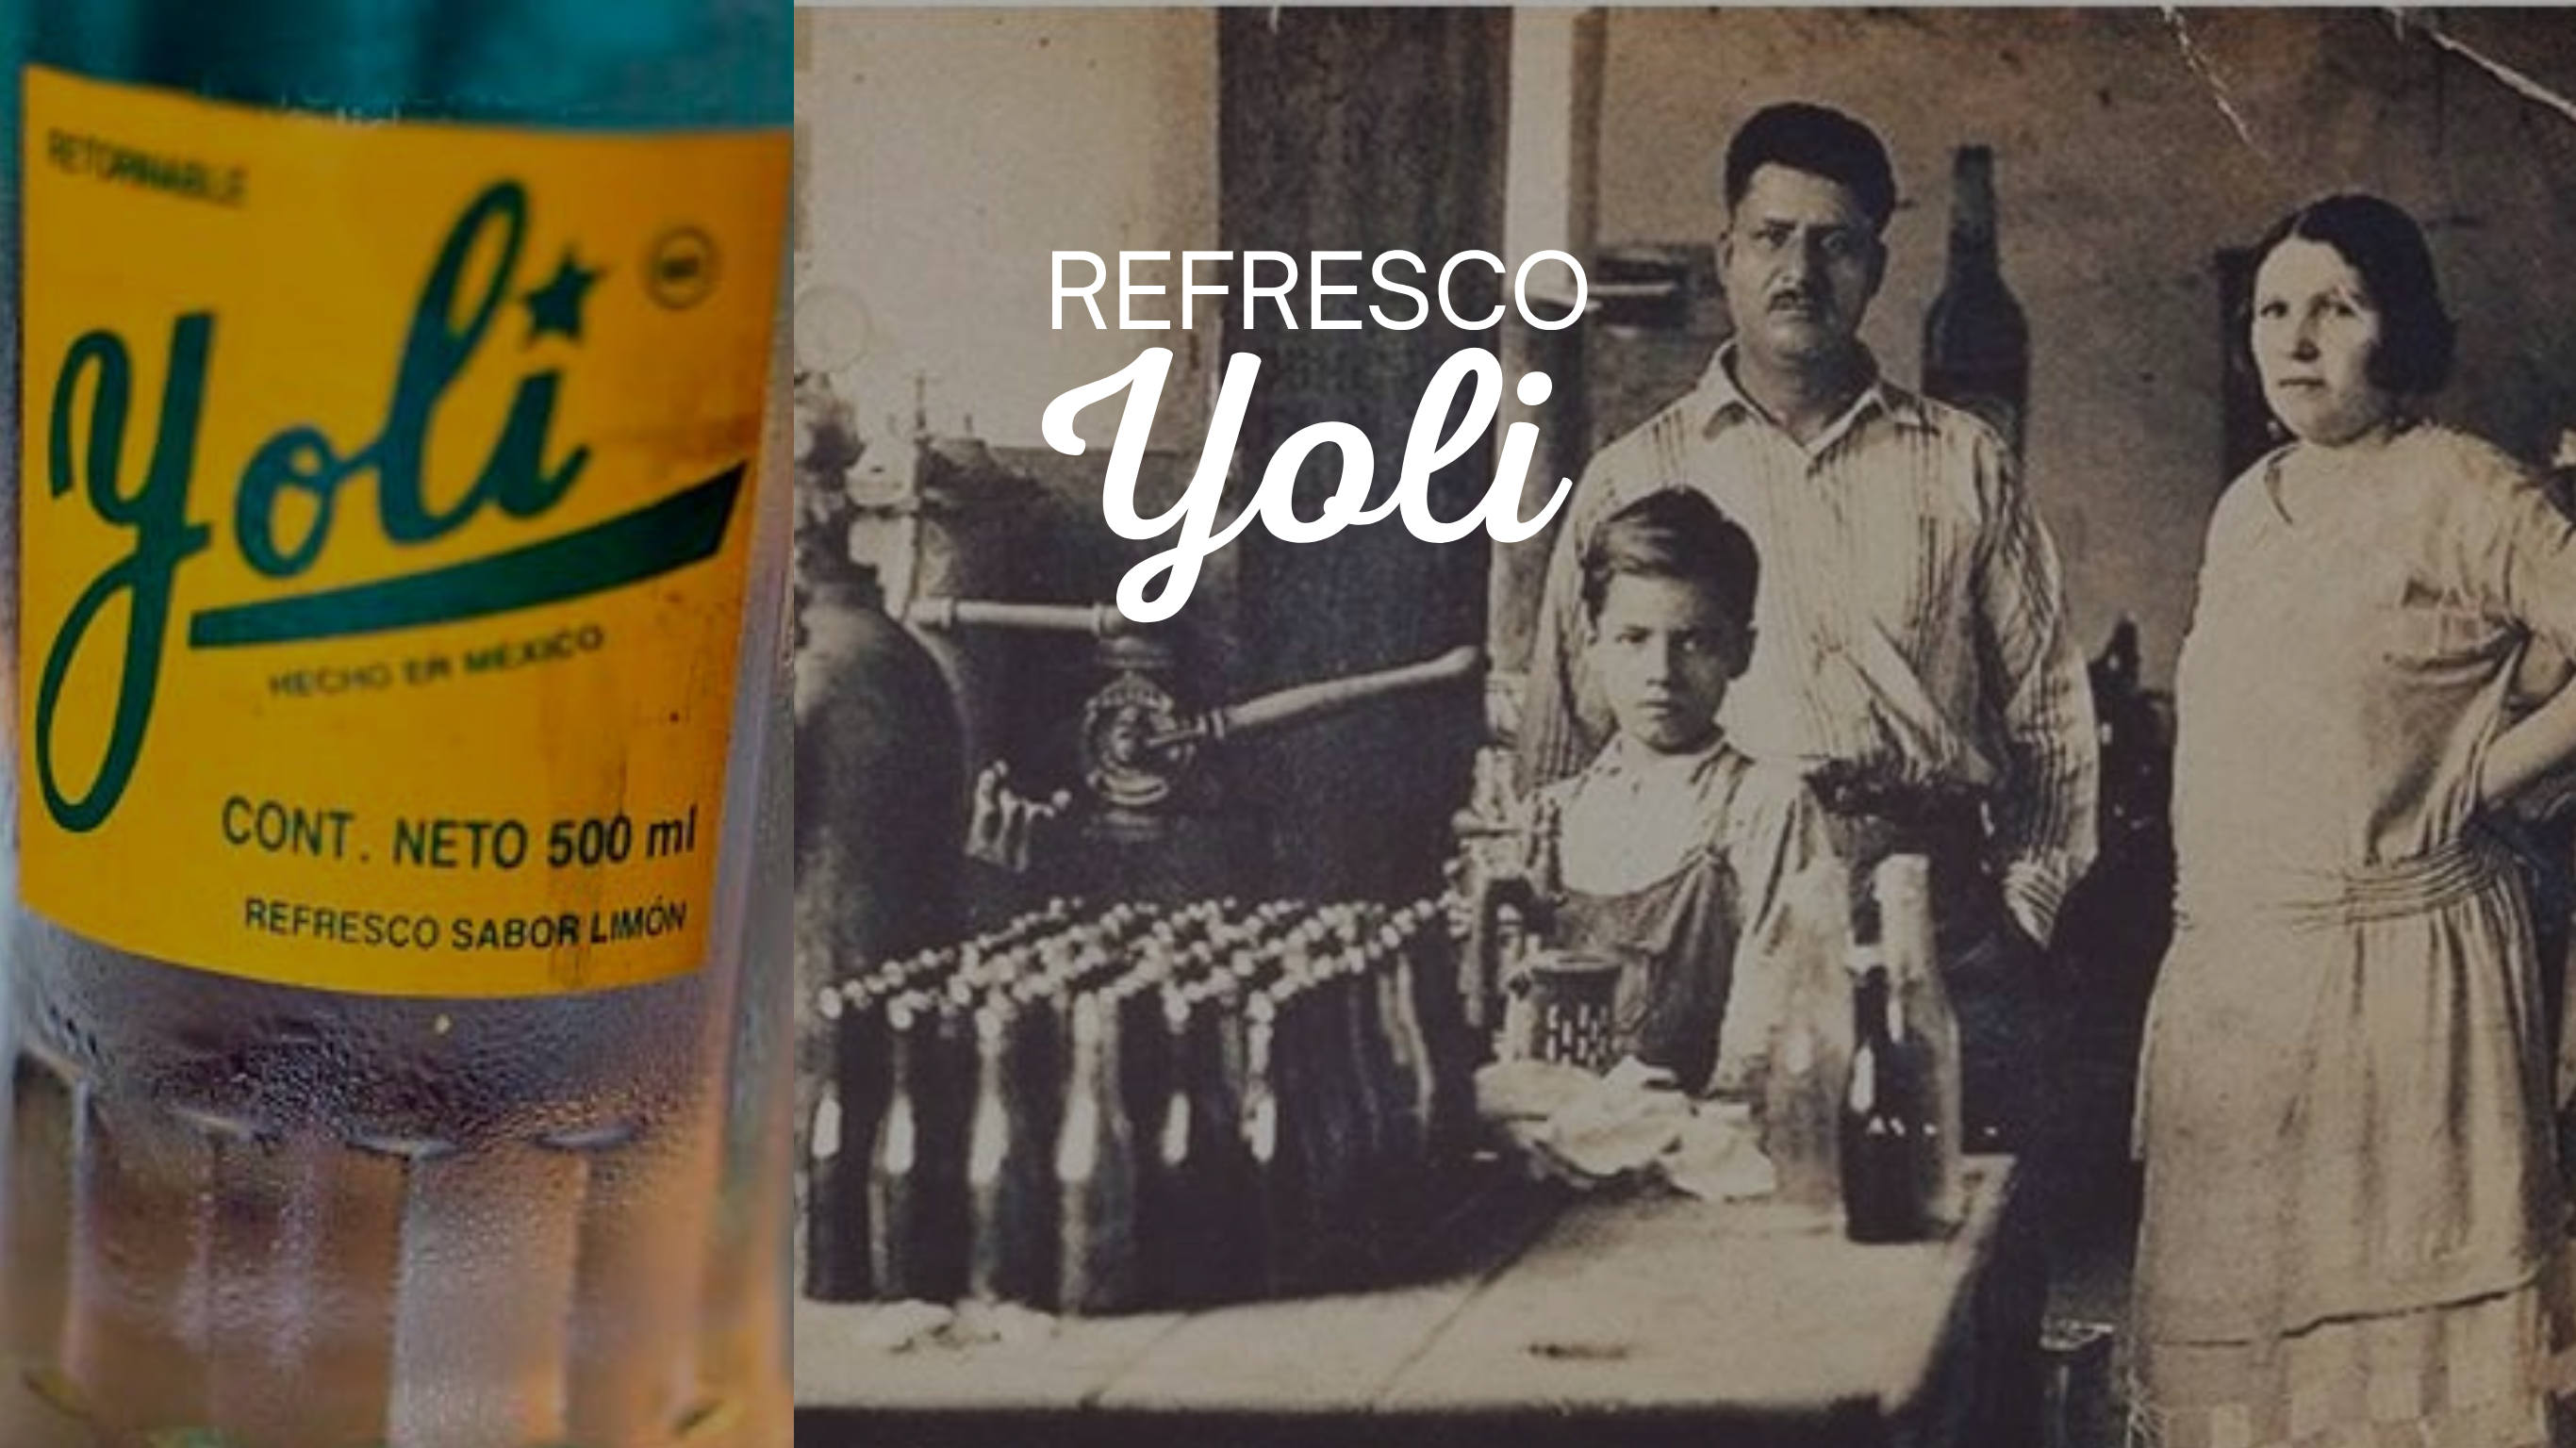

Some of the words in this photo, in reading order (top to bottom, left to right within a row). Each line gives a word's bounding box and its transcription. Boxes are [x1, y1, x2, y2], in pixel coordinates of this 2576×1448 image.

[36, 179, 603, 833] Yoli
[268, 665, 391, 699] HECHO
[392, 818, 529, 869] NETO
[547, 813, 633, 868] 500
[645, 804, 699, 859] ml
[244, 897, 439, 950] REFRESCO
[451, 914, 581, 950] SABOR
[589, 895, 688, 945] LIMÓN
